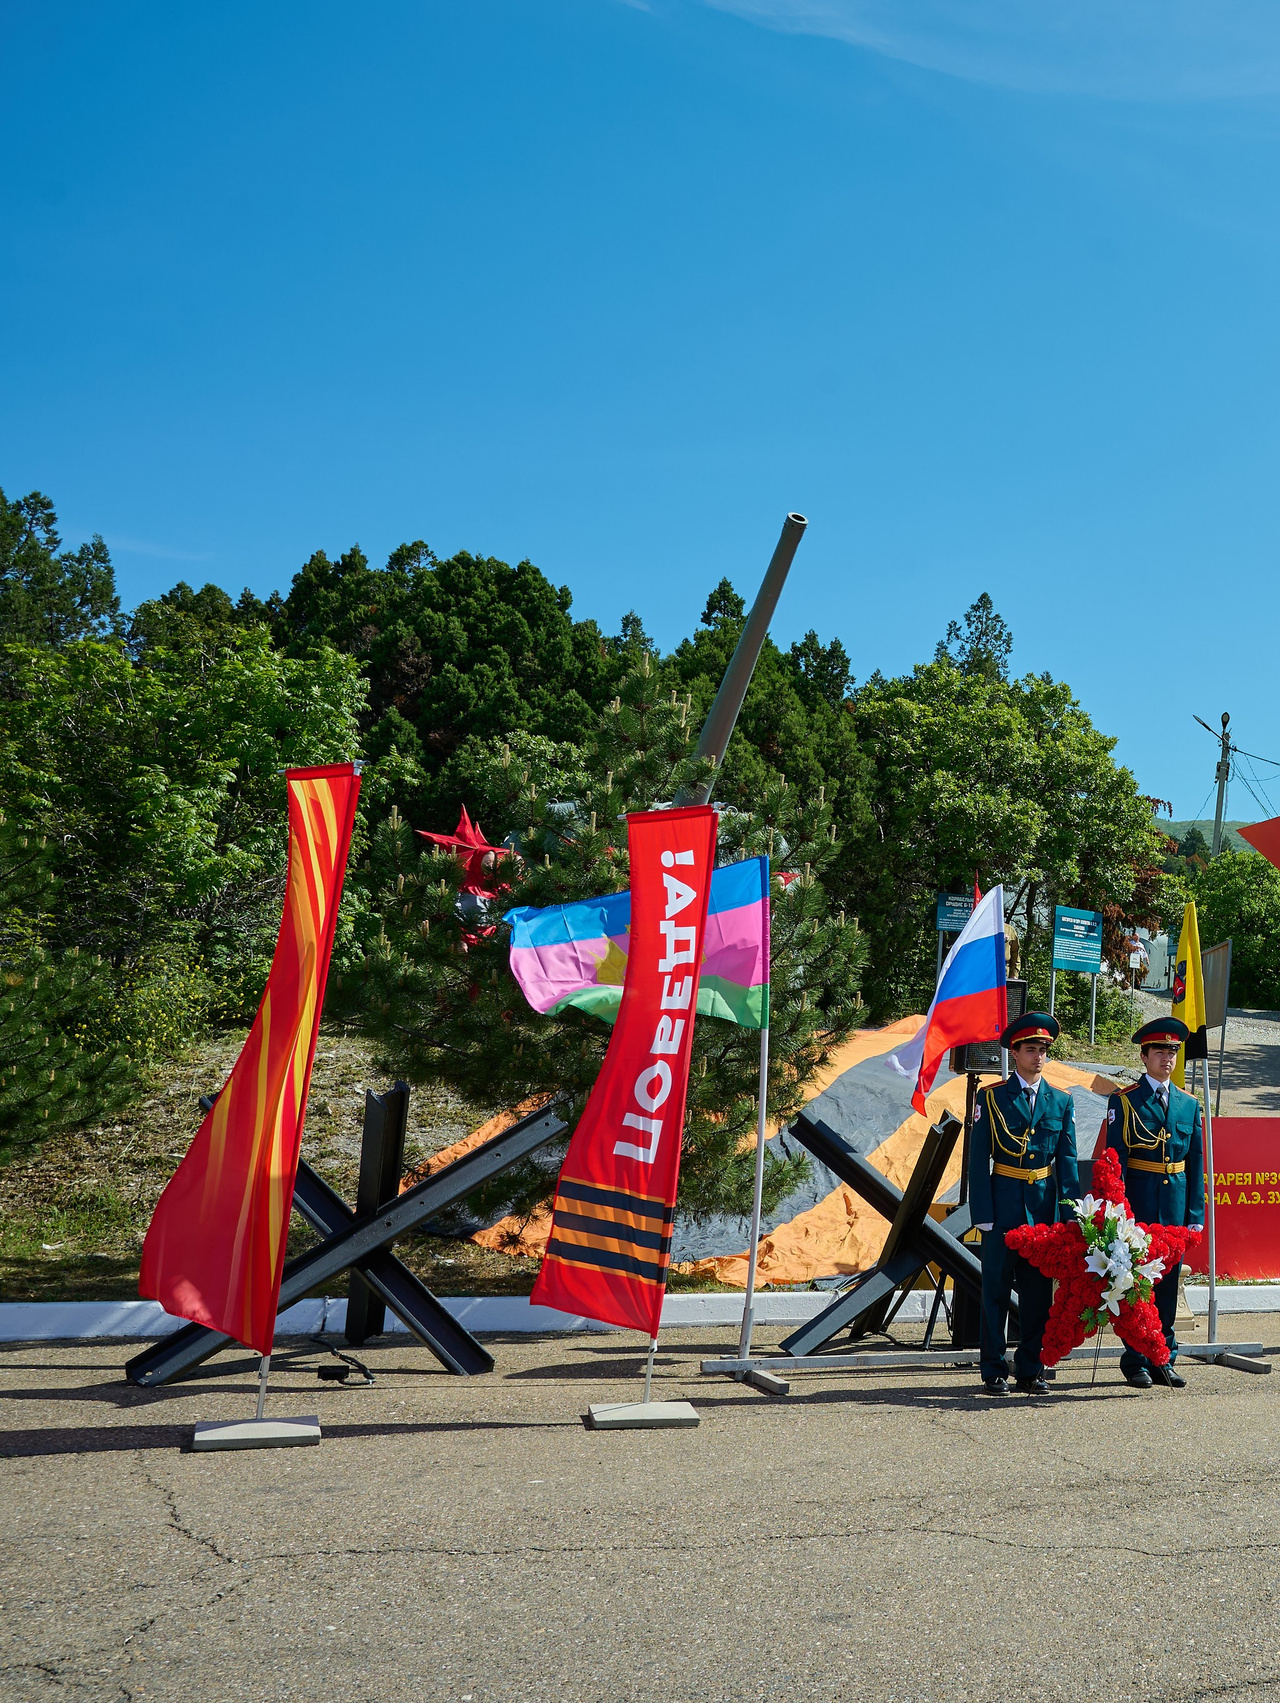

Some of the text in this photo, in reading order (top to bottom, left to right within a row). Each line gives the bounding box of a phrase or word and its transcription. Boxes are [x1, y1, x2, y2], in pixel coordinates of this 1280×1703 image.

[1203, 1173, 1251, 1186] АТАРЕЯ
[1204, 1192, 1232, 1205] АНА
[1237, 1192, 1264, 1204] А.Э.
